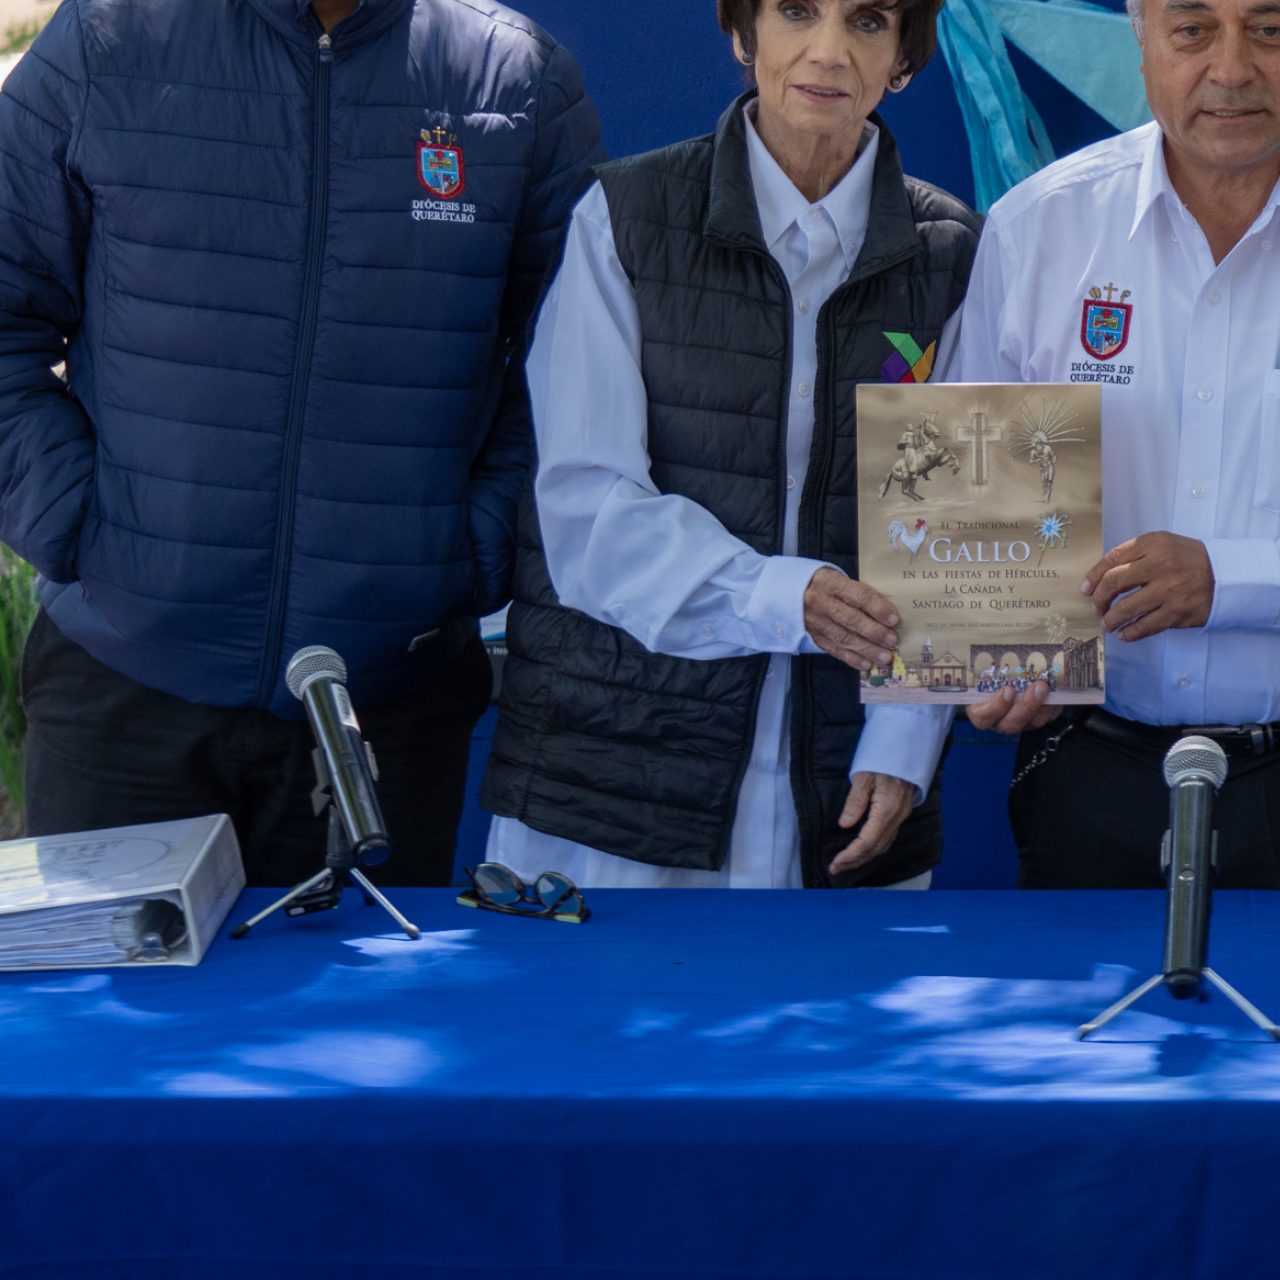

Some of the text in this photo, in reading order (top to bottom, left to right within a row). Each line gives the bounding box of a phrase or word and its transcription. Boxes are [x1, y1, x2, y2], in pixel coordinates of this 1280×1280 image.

[412, 199, 476, 213] DIÓCESIS DE
[412, 209, 474, 223] QUERÉTARO
[1072, 360, 1134, 375] DIÓCESIS DE
[1070, 372, 1130, 385] QUERÉTARO
[929, 537, 1031, 564] GALLO
[903, 570, 916, 579] EN
[922, 570, 939, 579] LAS
[945, 570, 982, 579] FIESTAS
[988, 570, 1001, 579] DE
[1008, 585, 1015, 594] Y
[912, 598, 1051, 611] SANTIAGO DE QUERÉTARO
